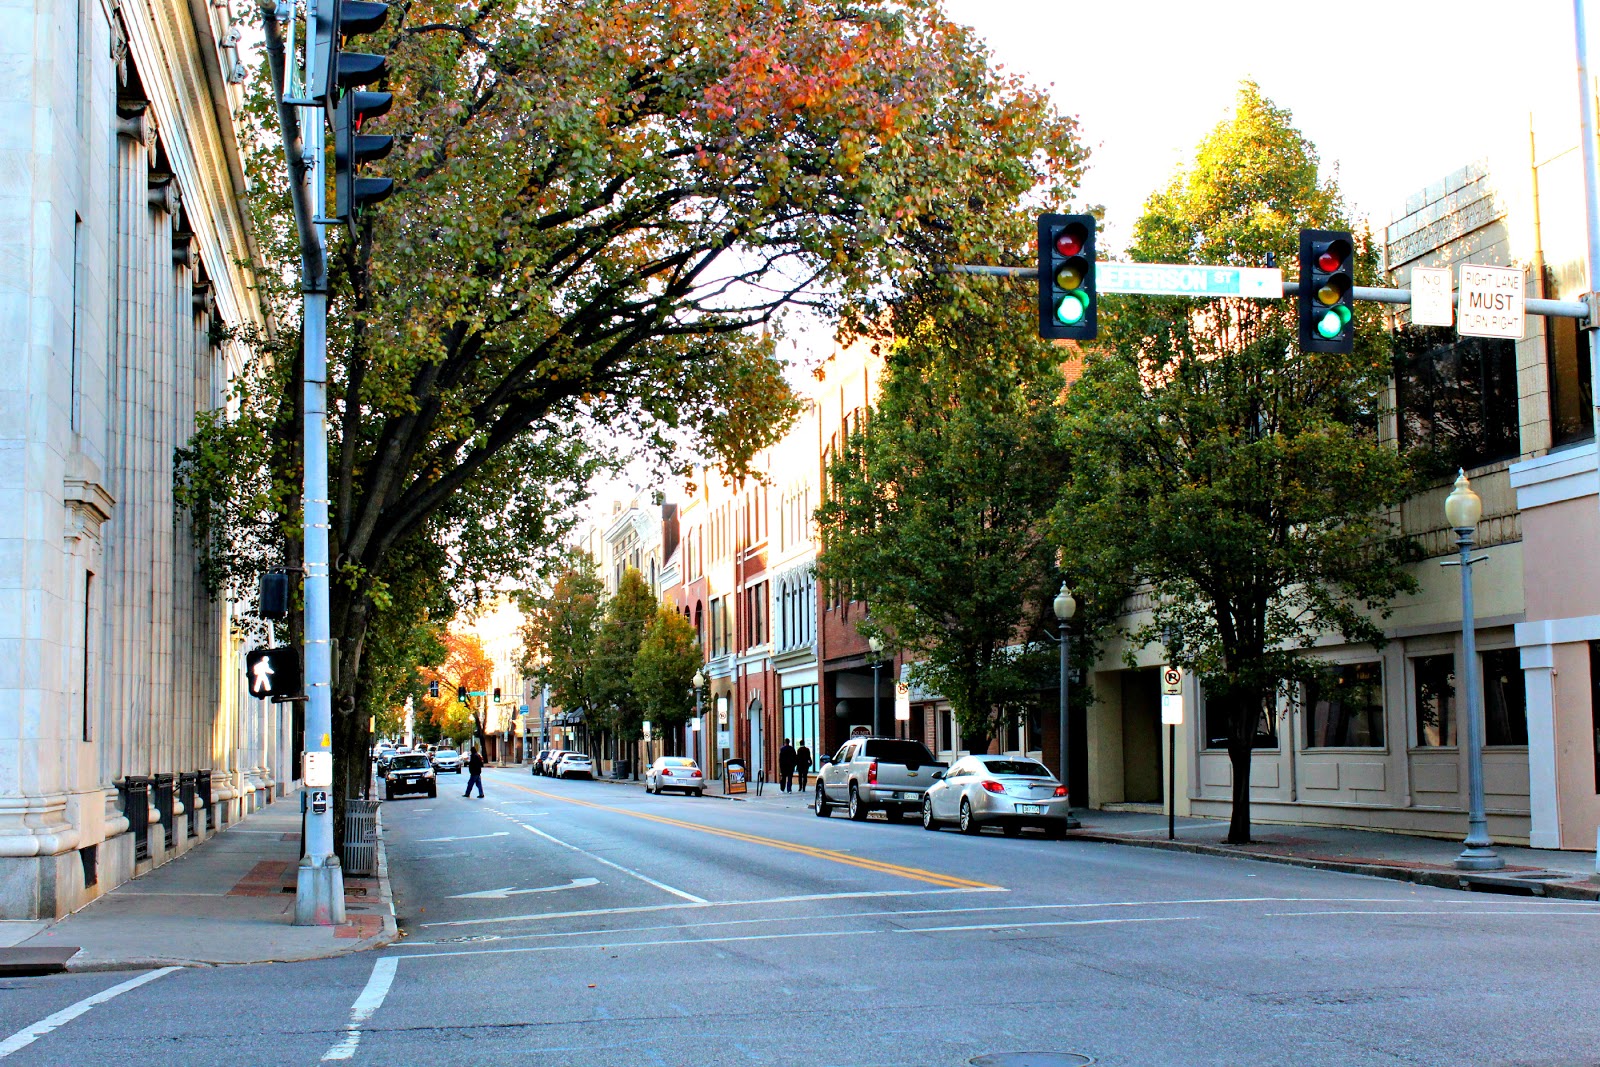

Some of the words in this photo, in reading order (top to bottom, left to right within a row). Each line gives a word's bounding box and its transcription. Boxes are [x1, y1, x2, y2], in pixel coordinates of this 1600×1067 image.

[1214, 271, 1233, 284] ST
[1423, 275, 1441, 286] NO
[1466, 272, 1492, 287] RIGHT
[1496, 276, 1519, 290] LANE
[1469, 292, 1514, 310] MUST
[1464, 314, 1488, 327] TURN
[1492, 316, 1519, 329] RIGHT
